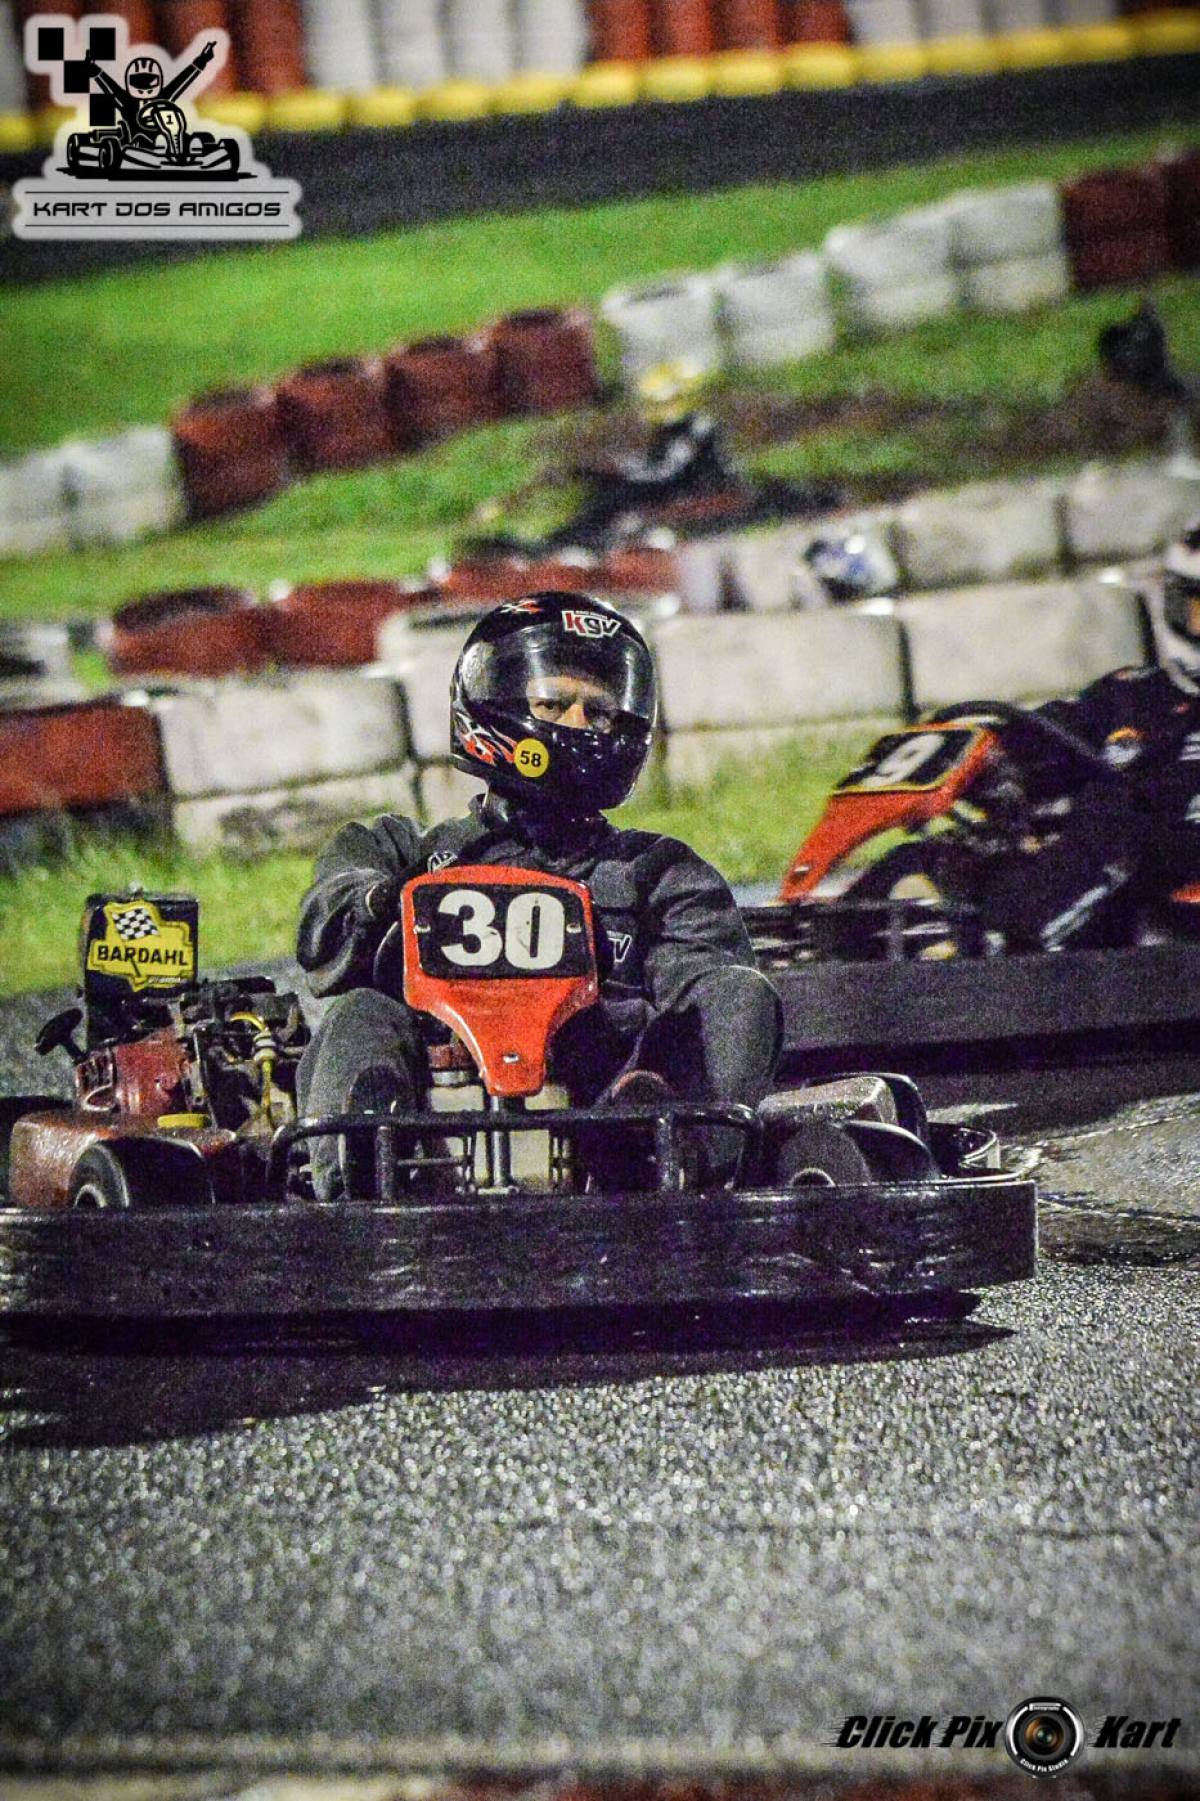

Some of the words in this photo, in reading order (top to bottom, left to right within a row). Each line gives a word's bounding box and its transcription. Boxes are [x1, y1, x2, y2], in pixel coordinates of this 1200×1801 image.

[519, 750, 542, 768] 58
[861, 733, 945, 787] 9
[437, 889, 565, 970] 30
[97, 945, 189, 967] BARDAHL
